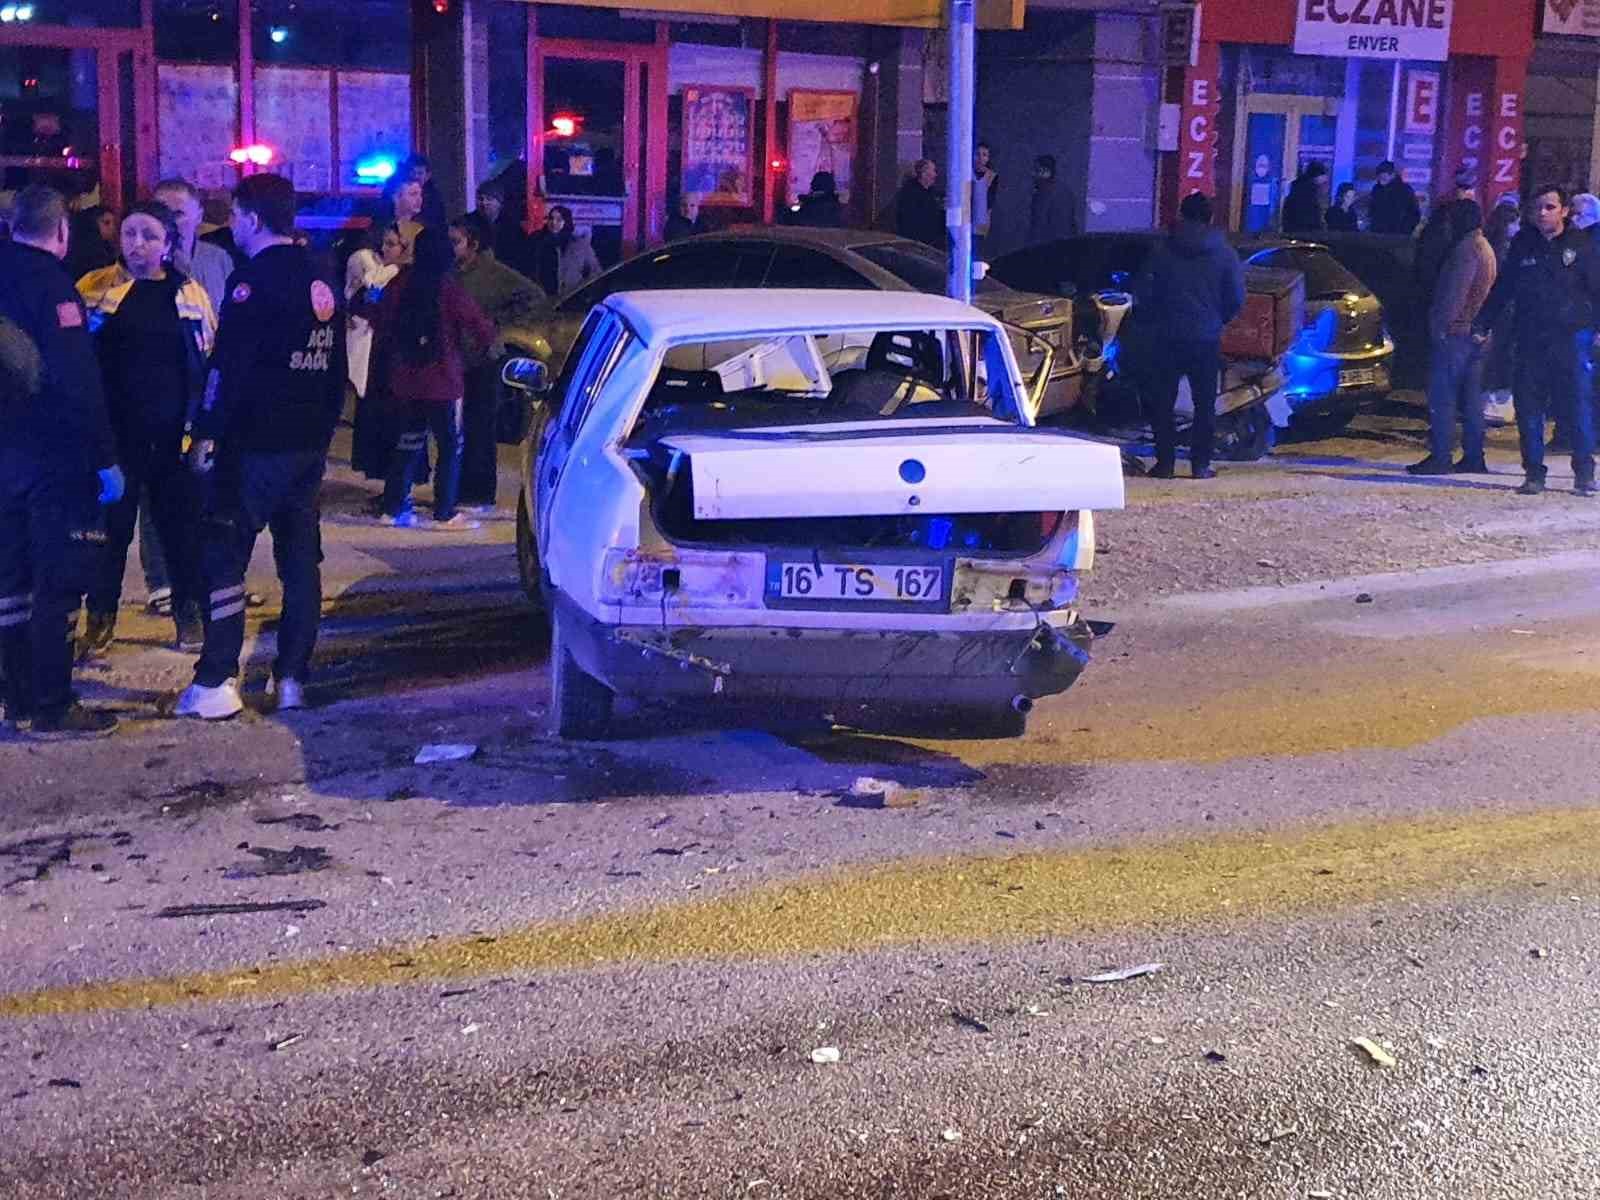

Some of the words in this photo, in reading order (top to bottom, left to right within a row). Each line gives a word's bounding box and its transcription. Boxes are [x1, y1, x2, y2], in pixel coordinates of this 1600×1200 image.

[1305, 0, 1446, 29] ECZANE
[1348, 35, 1399, 51] ENVER
[1187, 80, 1208, 194] ECZ
[785, 566, 812, 595] 16
[835, 567, 875, 596] TS
[895, 568, 940, 598] 167
